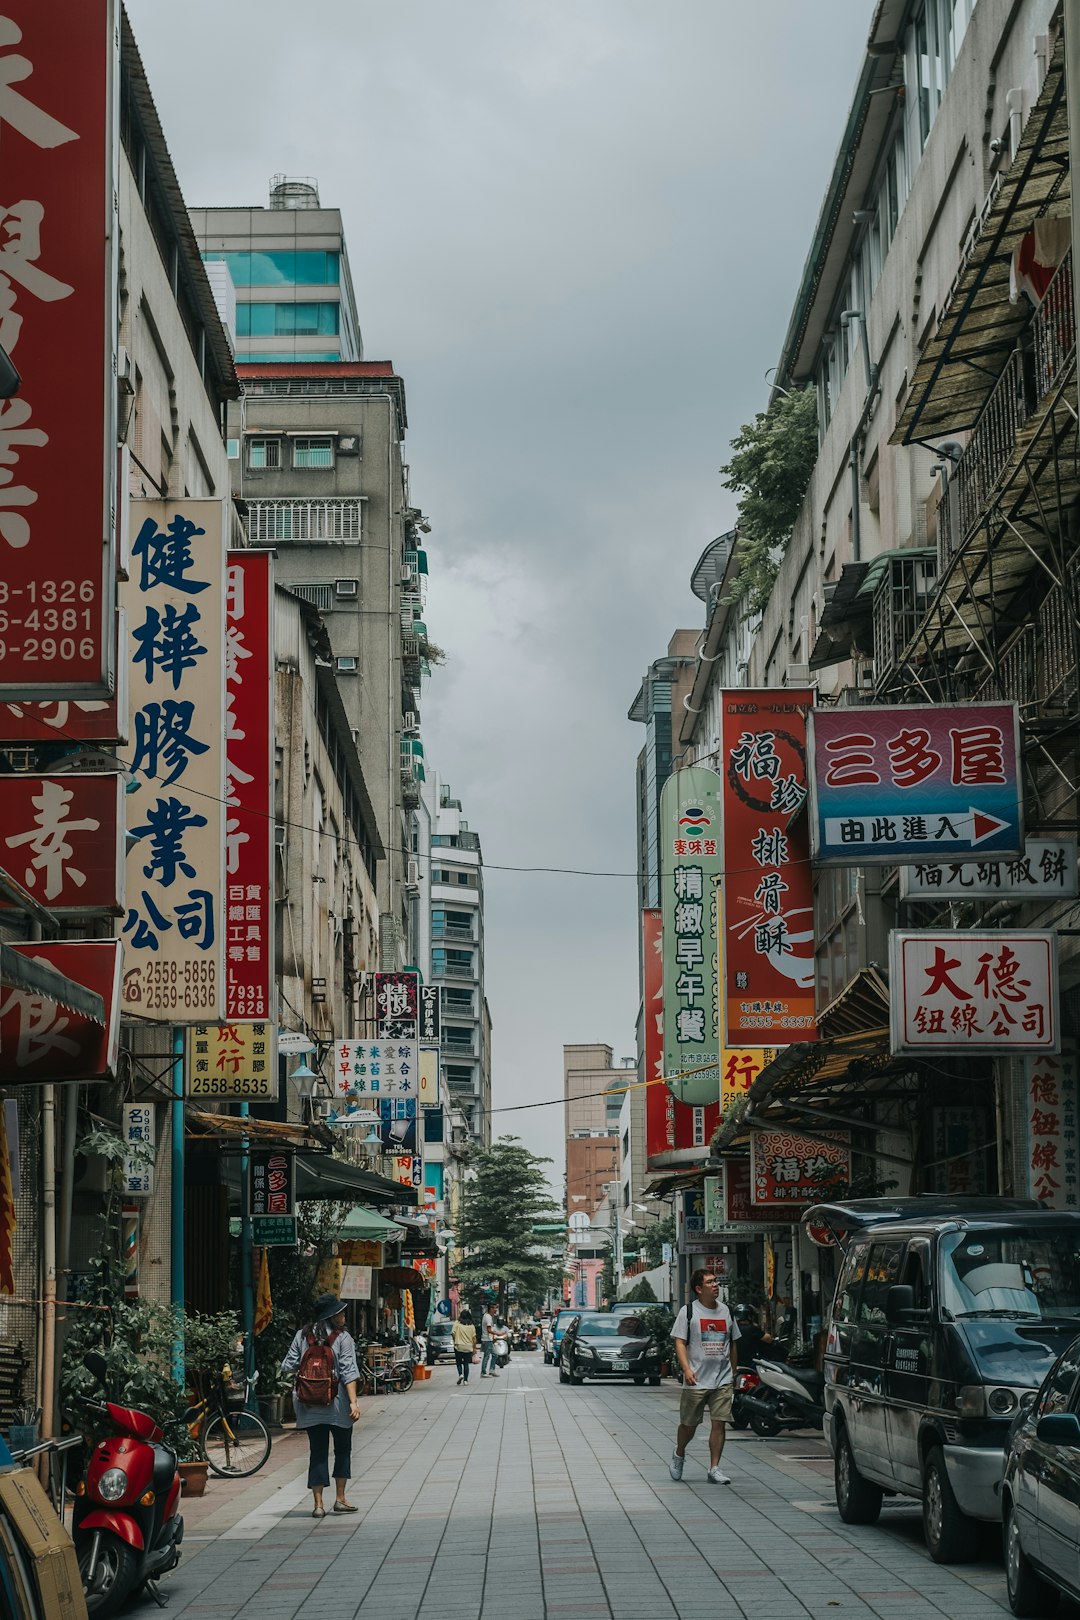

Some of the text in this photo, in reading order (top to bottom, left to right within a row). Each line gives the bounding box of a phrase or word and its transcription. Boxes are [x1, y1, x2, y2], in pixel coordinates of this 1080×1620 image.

[825, 725, 1006, 788] 三多屋
[5, 780, 100, 900] 素
[840, 816, 959, 843] 由此進入
[674, 840, 717, 855] 麥味登
[228, 884, 261, 901] 百貨
[752, 826, 793, 956] 排骨酥
[228, 905, 261, 921] 總匯
[228, 925, 261, 941] 工具
[228, 945, 261, 961] 零售
[674, 865, 705, 1043] 精緻早午餐
[146, 960, 216, 984] 2558-5856
[921, 945, 1031, 1002] 大德
[146, 985, 216, 1008] 2559-6336
[740, 1015, 814, 1028] 2555-3337
[913, 1003, 1045, 1039] 鈕線公司
[338, 1044, 351, 1092] 古早味
[369, 1045, 381, 1092] 米苔目
[383, 1045, 397, 1092] 愛玉子
[193, 1078, 268, 1093] 2558-8535
[253, 1165, 265, 1213] 關係企業
